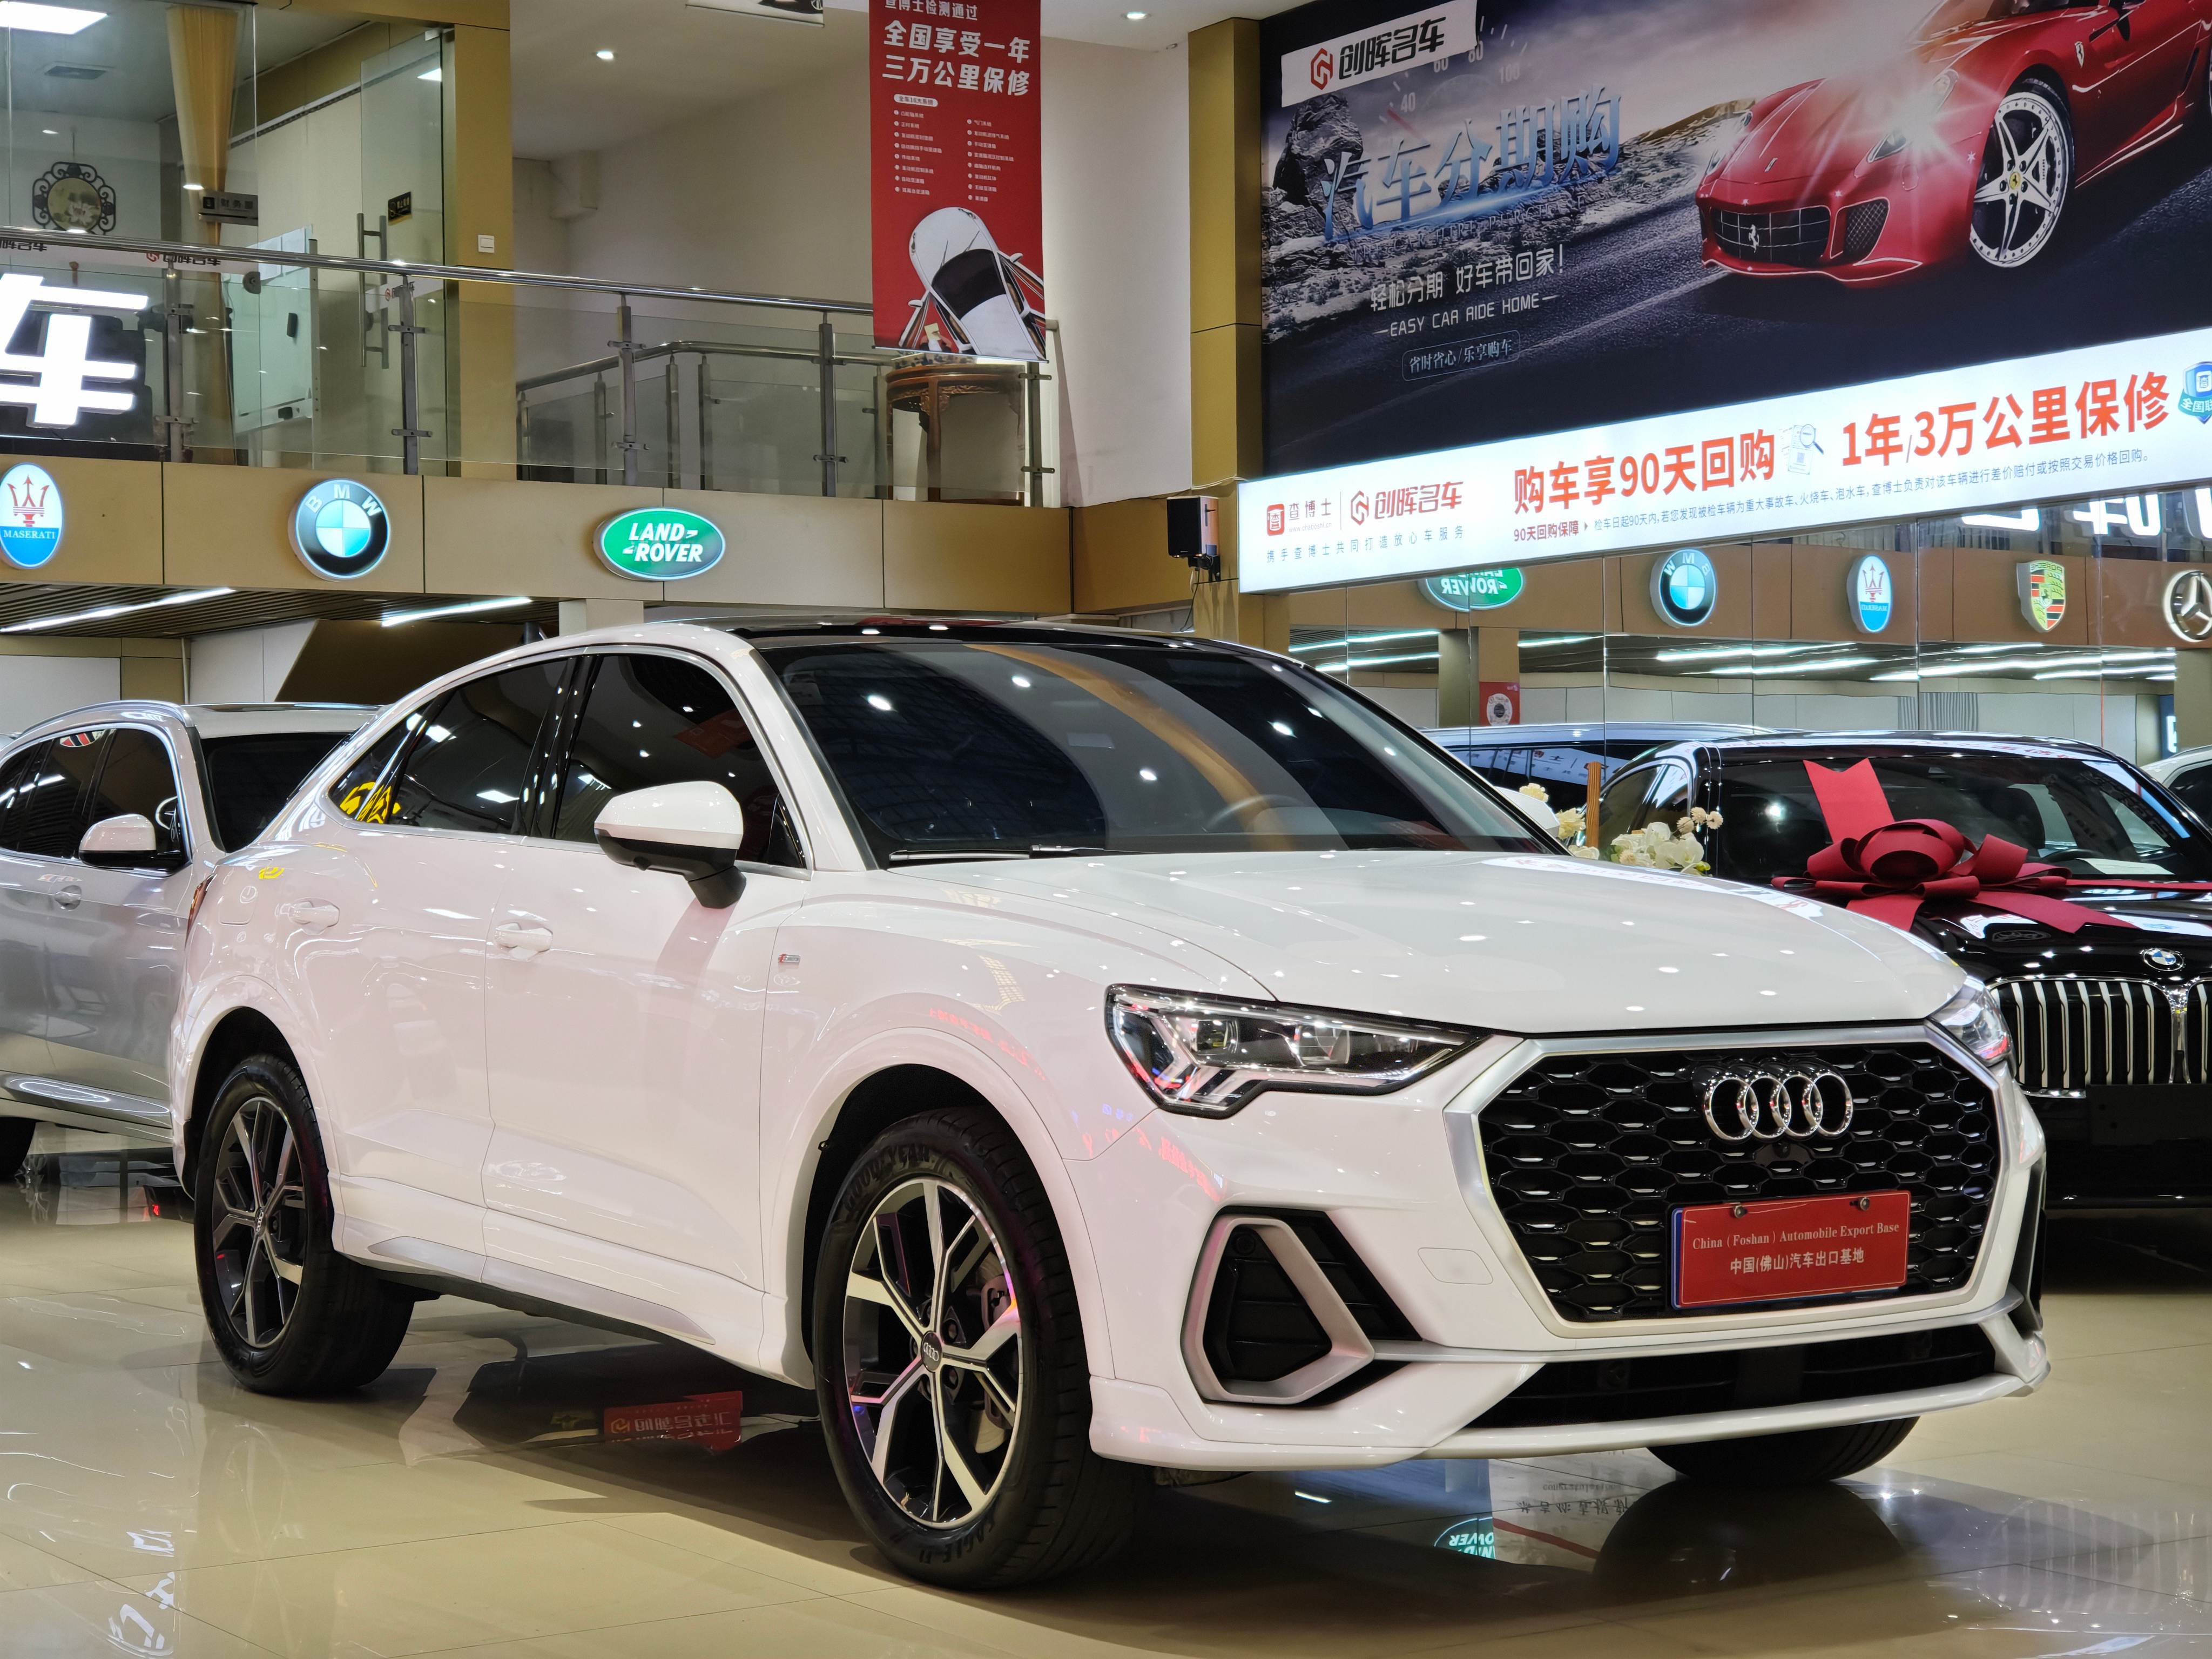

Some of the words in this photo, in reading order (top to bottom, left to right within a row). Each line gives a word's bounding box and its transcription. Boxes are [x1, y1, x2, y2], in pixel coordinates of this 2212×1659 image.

[884, 20, 1030, 63] 全国享受一年
[1339, 17, 1446, 80] 创晖名车
[882, 55, 1030, 96] 三万公里保修
[1400, 92, 1416, 112] 40
[1321, 84, 1621, 242] 汽车分期购
[1371, 271, 1444, 312] 轻松分期
[1456, 244, 1563, 295] 好车带回家!
[1390, 316, 1425, 337] EASY
[1432, 309, 1459, 328] CAR
[1466, 301, 1495, 322] RIDE
[1502, 292, 1539, 315] HOME
[1842, 371, 2170, 467] 1年/3万公里保修
[1514, 428, 1775, 515] 购车享90天回购
[305, 484, 382, 517] BMW
[1289, 498, 1332, 521] 查博士
[1374, 482, 1464, 520] 创晖名车
[3, 530, 56, 539] MASERATI
[629, 522, 685, 541] LAND
[1267, 525, 1464, 563] 携手查博士共同打造放心车服务
[1289, 522, 1332, 533] www.chaboshi.cn
[1513, 520, 1579, 542] 90天回购保障
[634, 543, 703, 562] ROVER
[1692, 1237, 1723, 1250] China
[1780, 1226, 1838, 1243] Automobile
[1840, 1224, 1875, 1238] Export
[1877, 1222, 1900, 1235] Base
